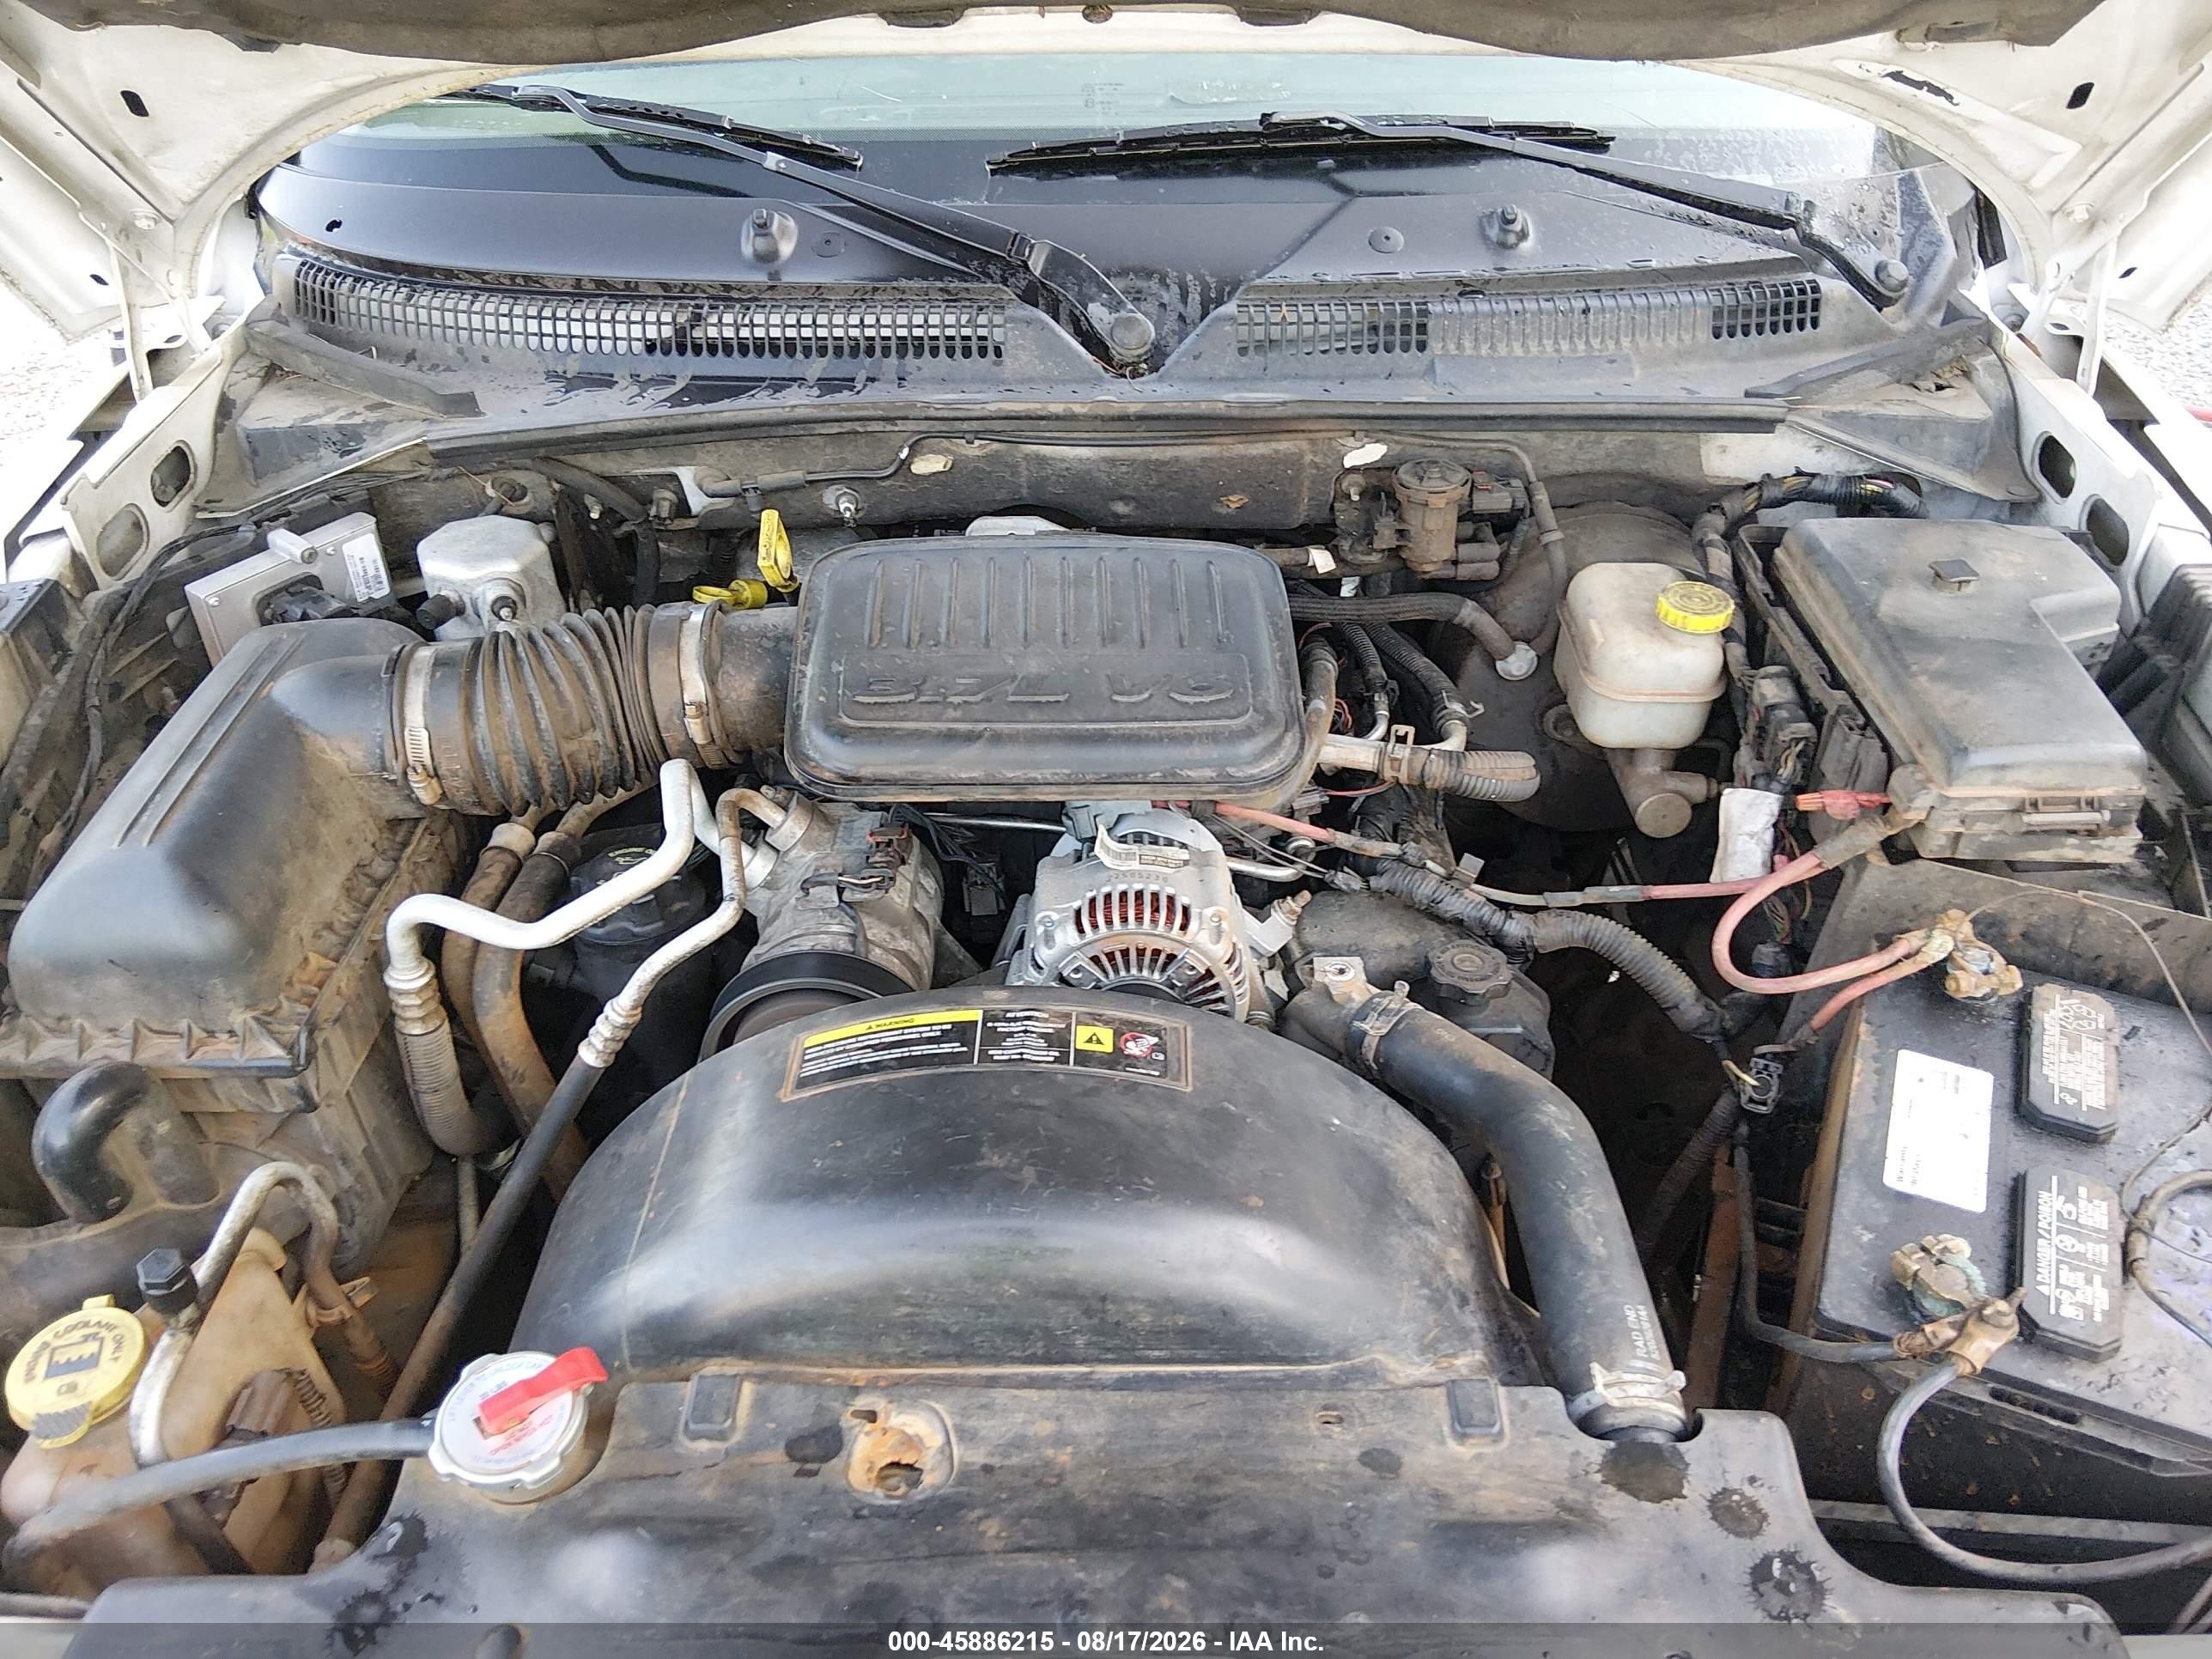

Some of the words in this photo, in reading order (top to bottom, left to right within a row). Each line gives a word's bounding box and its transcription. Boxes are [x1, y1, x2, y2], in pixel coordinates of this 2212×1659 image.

[1106, 672, 1237, 705] V6
[1623, 1304, 1640, 1329] END
[53, 1319, 120, 1340] COOLANT
[111, 1333, 125, 1364] ONLY
[1631, 1331, 1650, 1358] RAD
